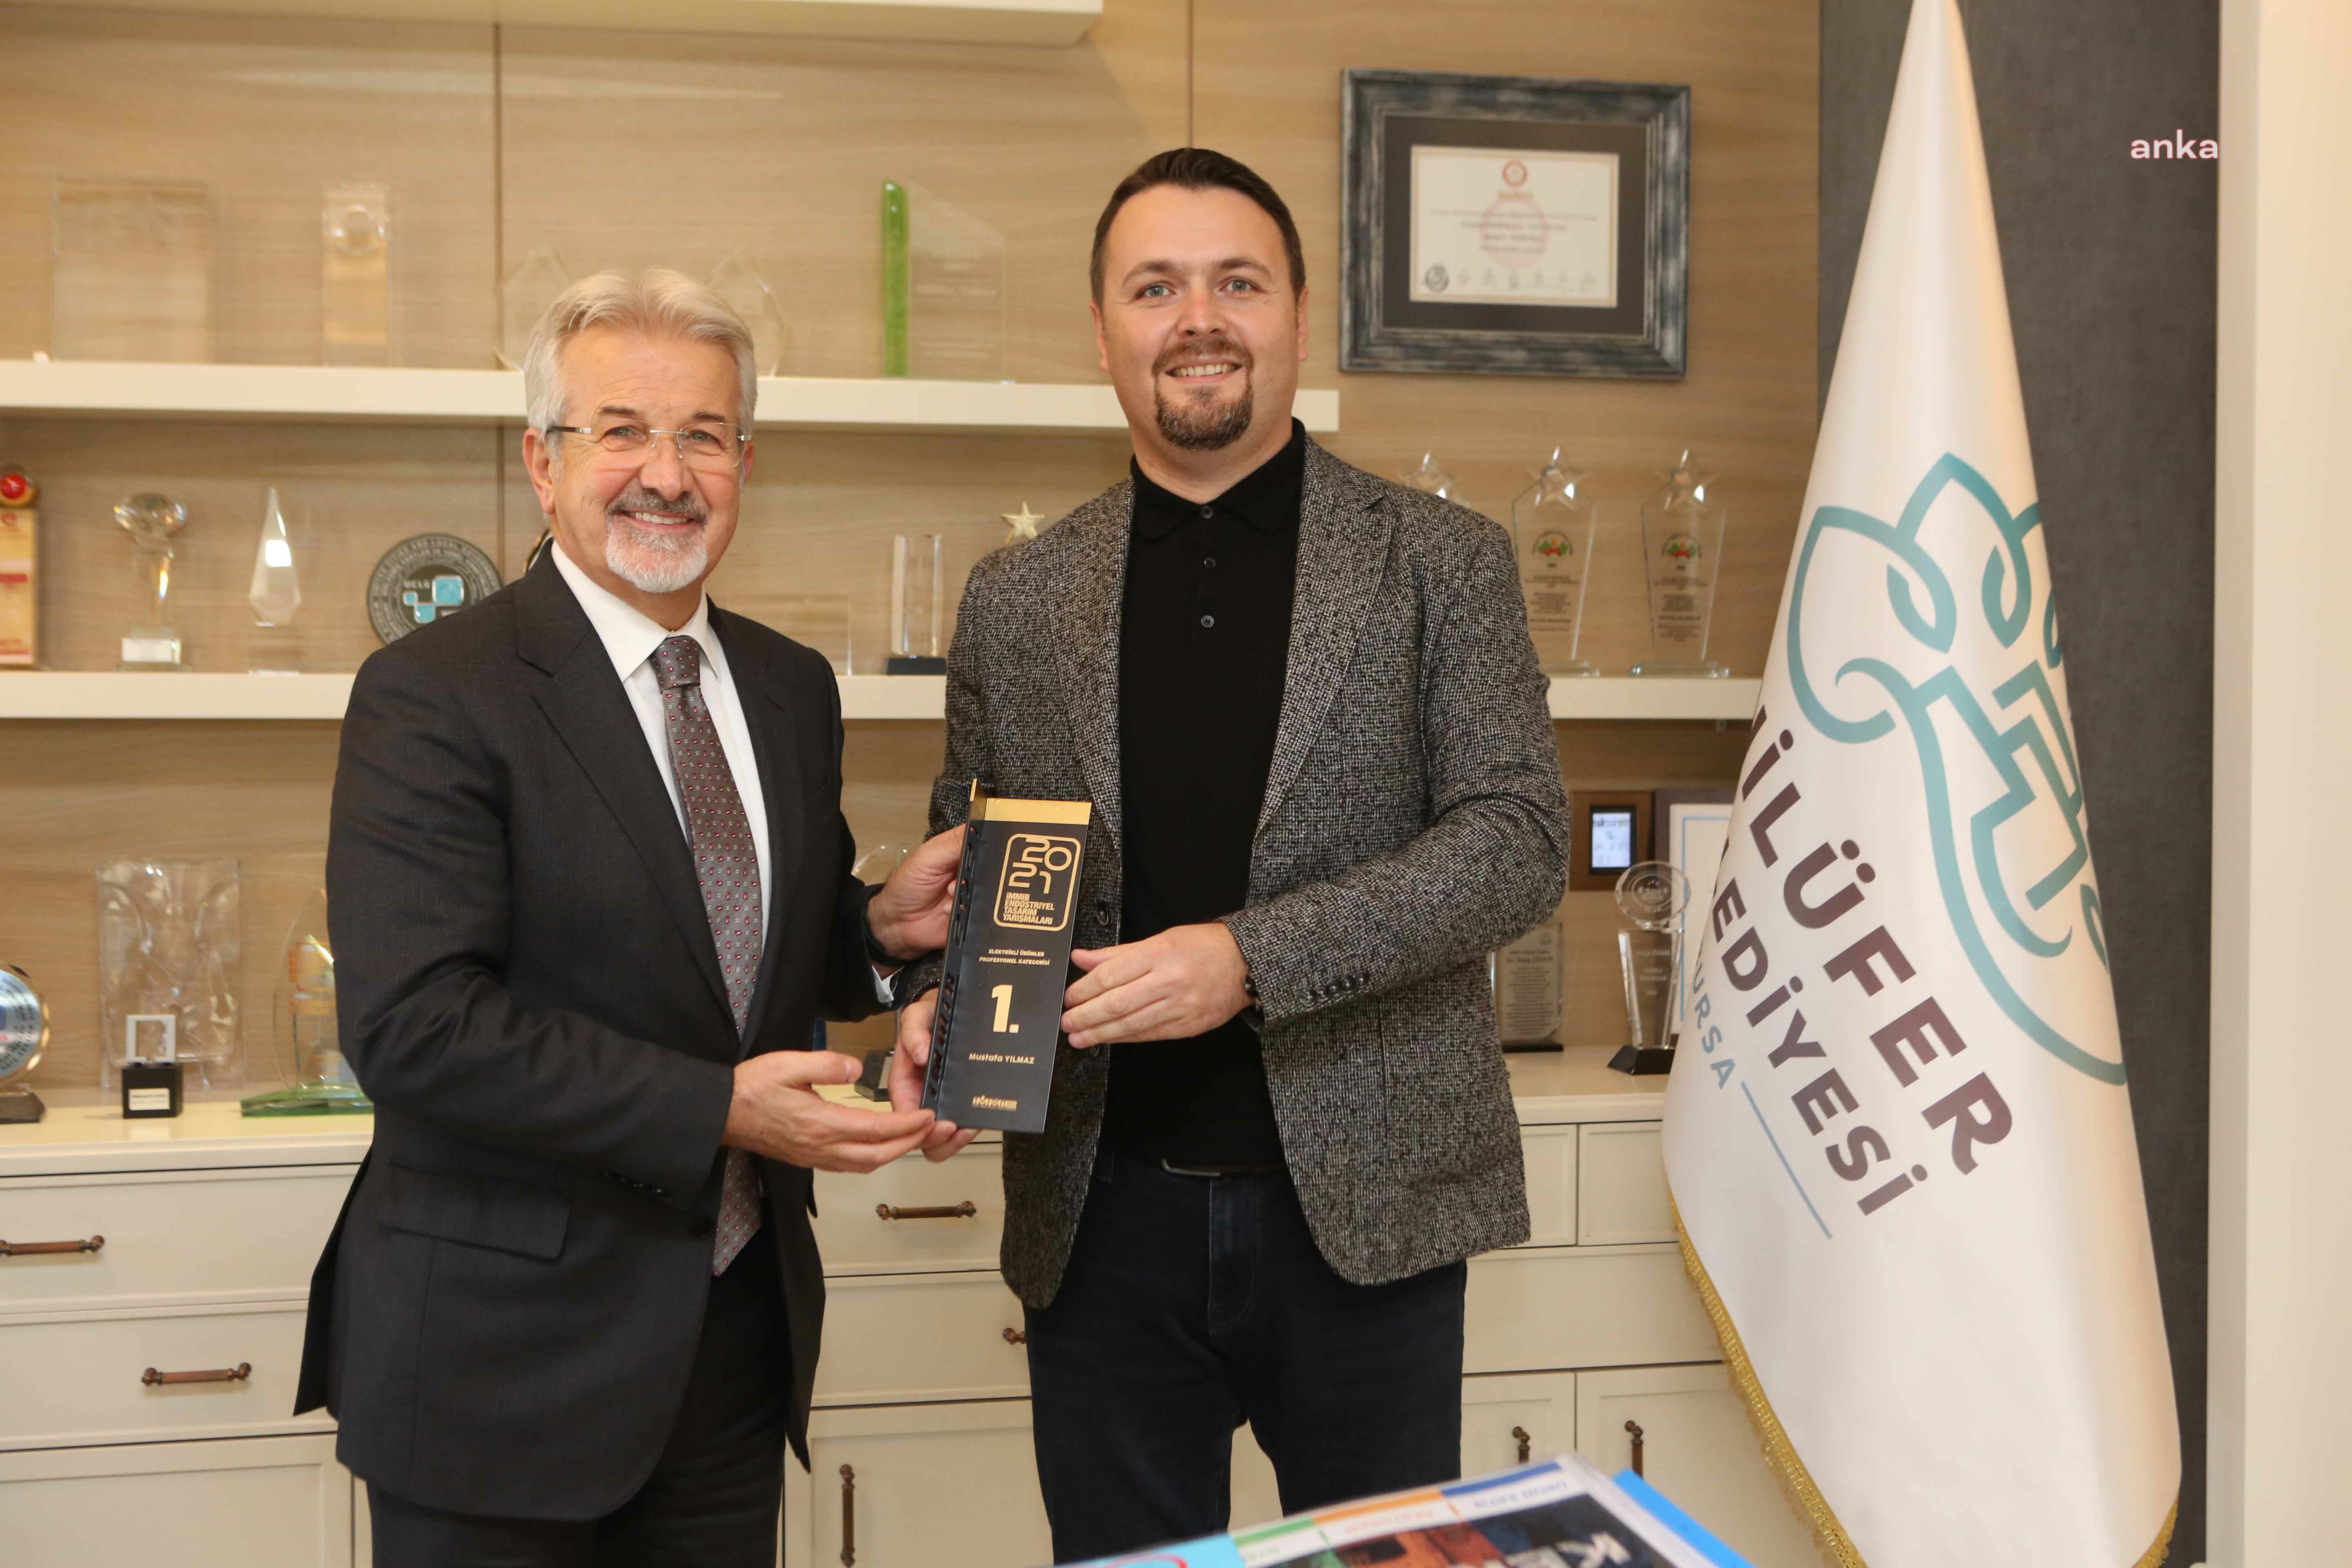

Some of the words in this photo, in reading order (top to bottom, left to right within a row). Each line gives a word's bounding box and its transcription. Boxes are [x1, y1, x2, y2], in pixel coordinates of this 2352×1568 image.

[1003, 913, 1053, 925] YARIŞMALARI
[1004, 907, 1038, 916] TASARIM
[991, 984, 1019, 1033] 1.
[1693, 941, 1735, 1089] URSA
[1713, 837, 1928, 1217] EDİYESİ
[969, 1053, 1003, 1062] Mustafa
[1005, 1055, 1035, 1065] YILMAZ
